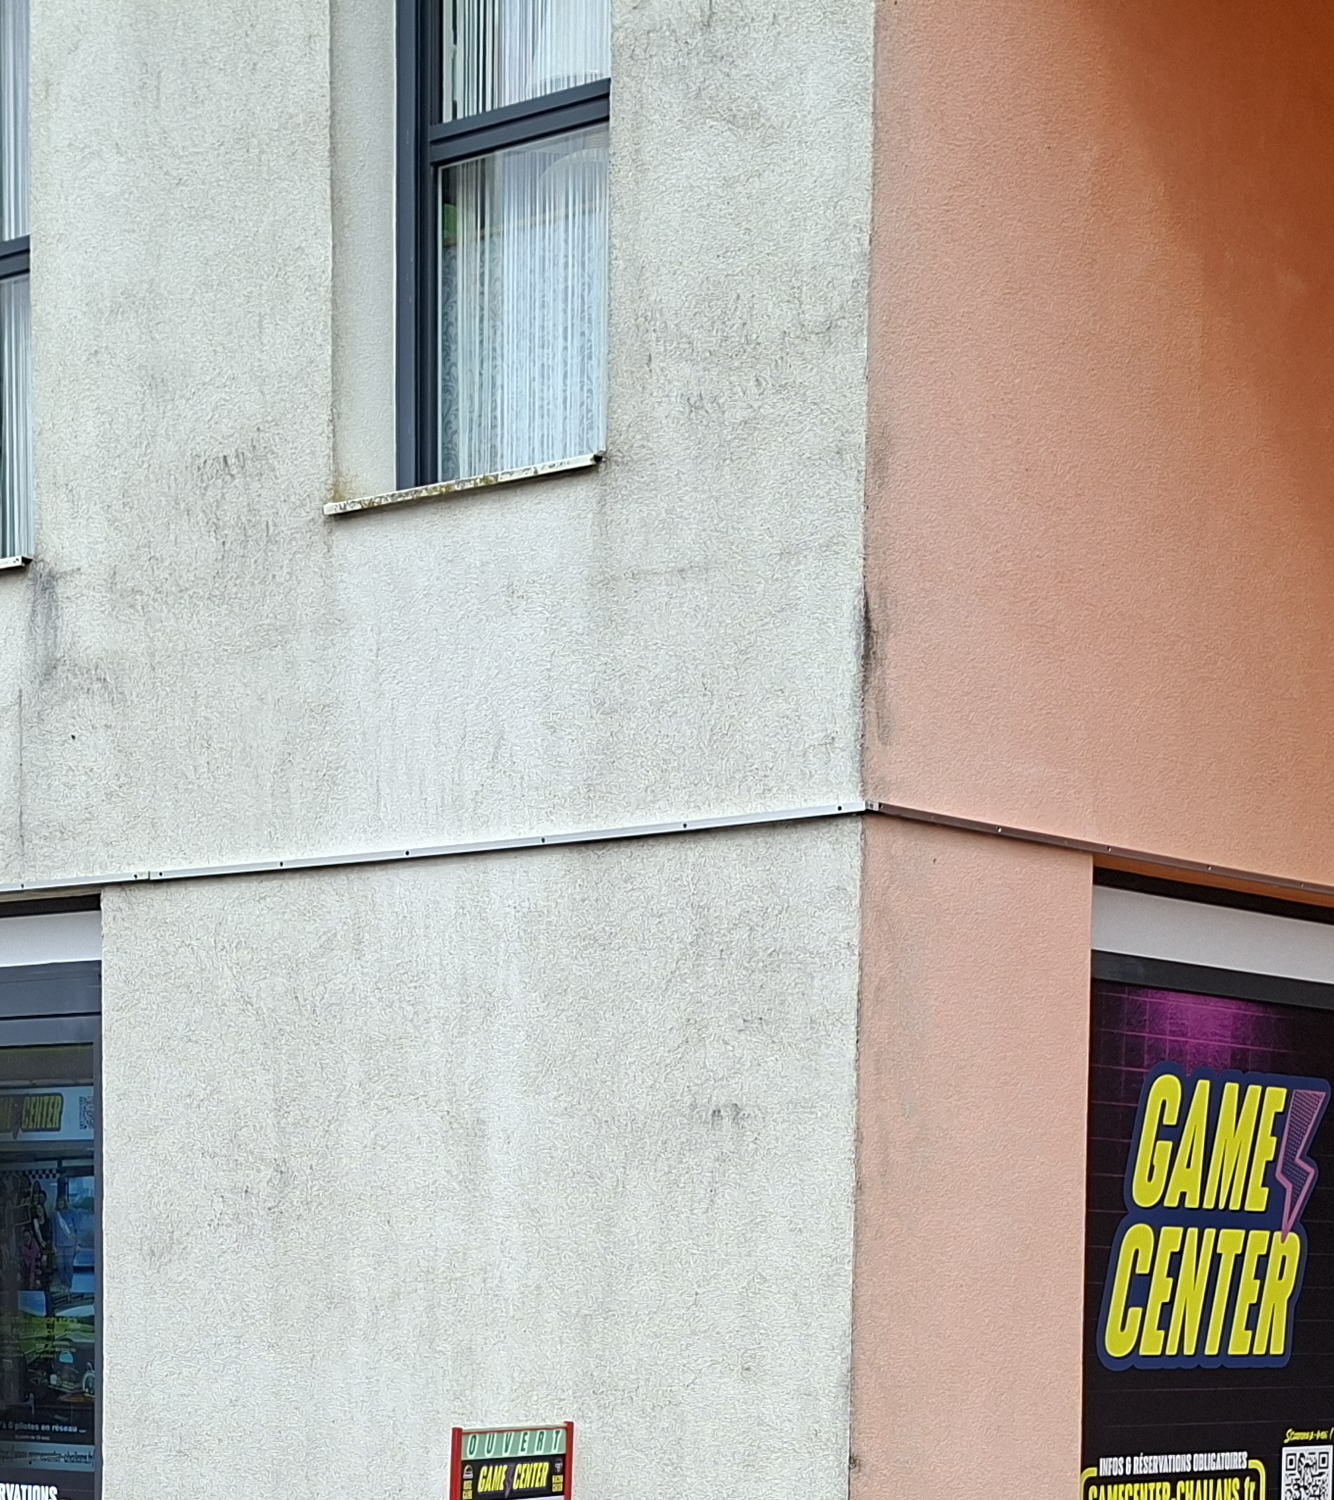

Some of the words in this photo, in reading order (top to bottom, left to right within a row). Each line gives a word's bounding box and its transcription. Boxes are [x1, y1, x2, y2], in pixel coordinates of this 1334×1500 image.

[22, 1095, 62, 1129] CENTER
[1132, 1074, 1287, 1211] GAME
[1105, 1223, 1300, 1358] CENTER
[468, 1429, 562, 1457] OUVERT
[477, 1465, 508, 1493] GAME
[513, 1462, 549, 1490] CENTER
[1099, 1456, 1124, 1477] INFOS
[1125, 1457, 1132, 1476] &
[1133, 1453, 1192, 1475] RÉSERVATIONS
[1193, 1451, 1248, 1473] OBLIGATOIRES
